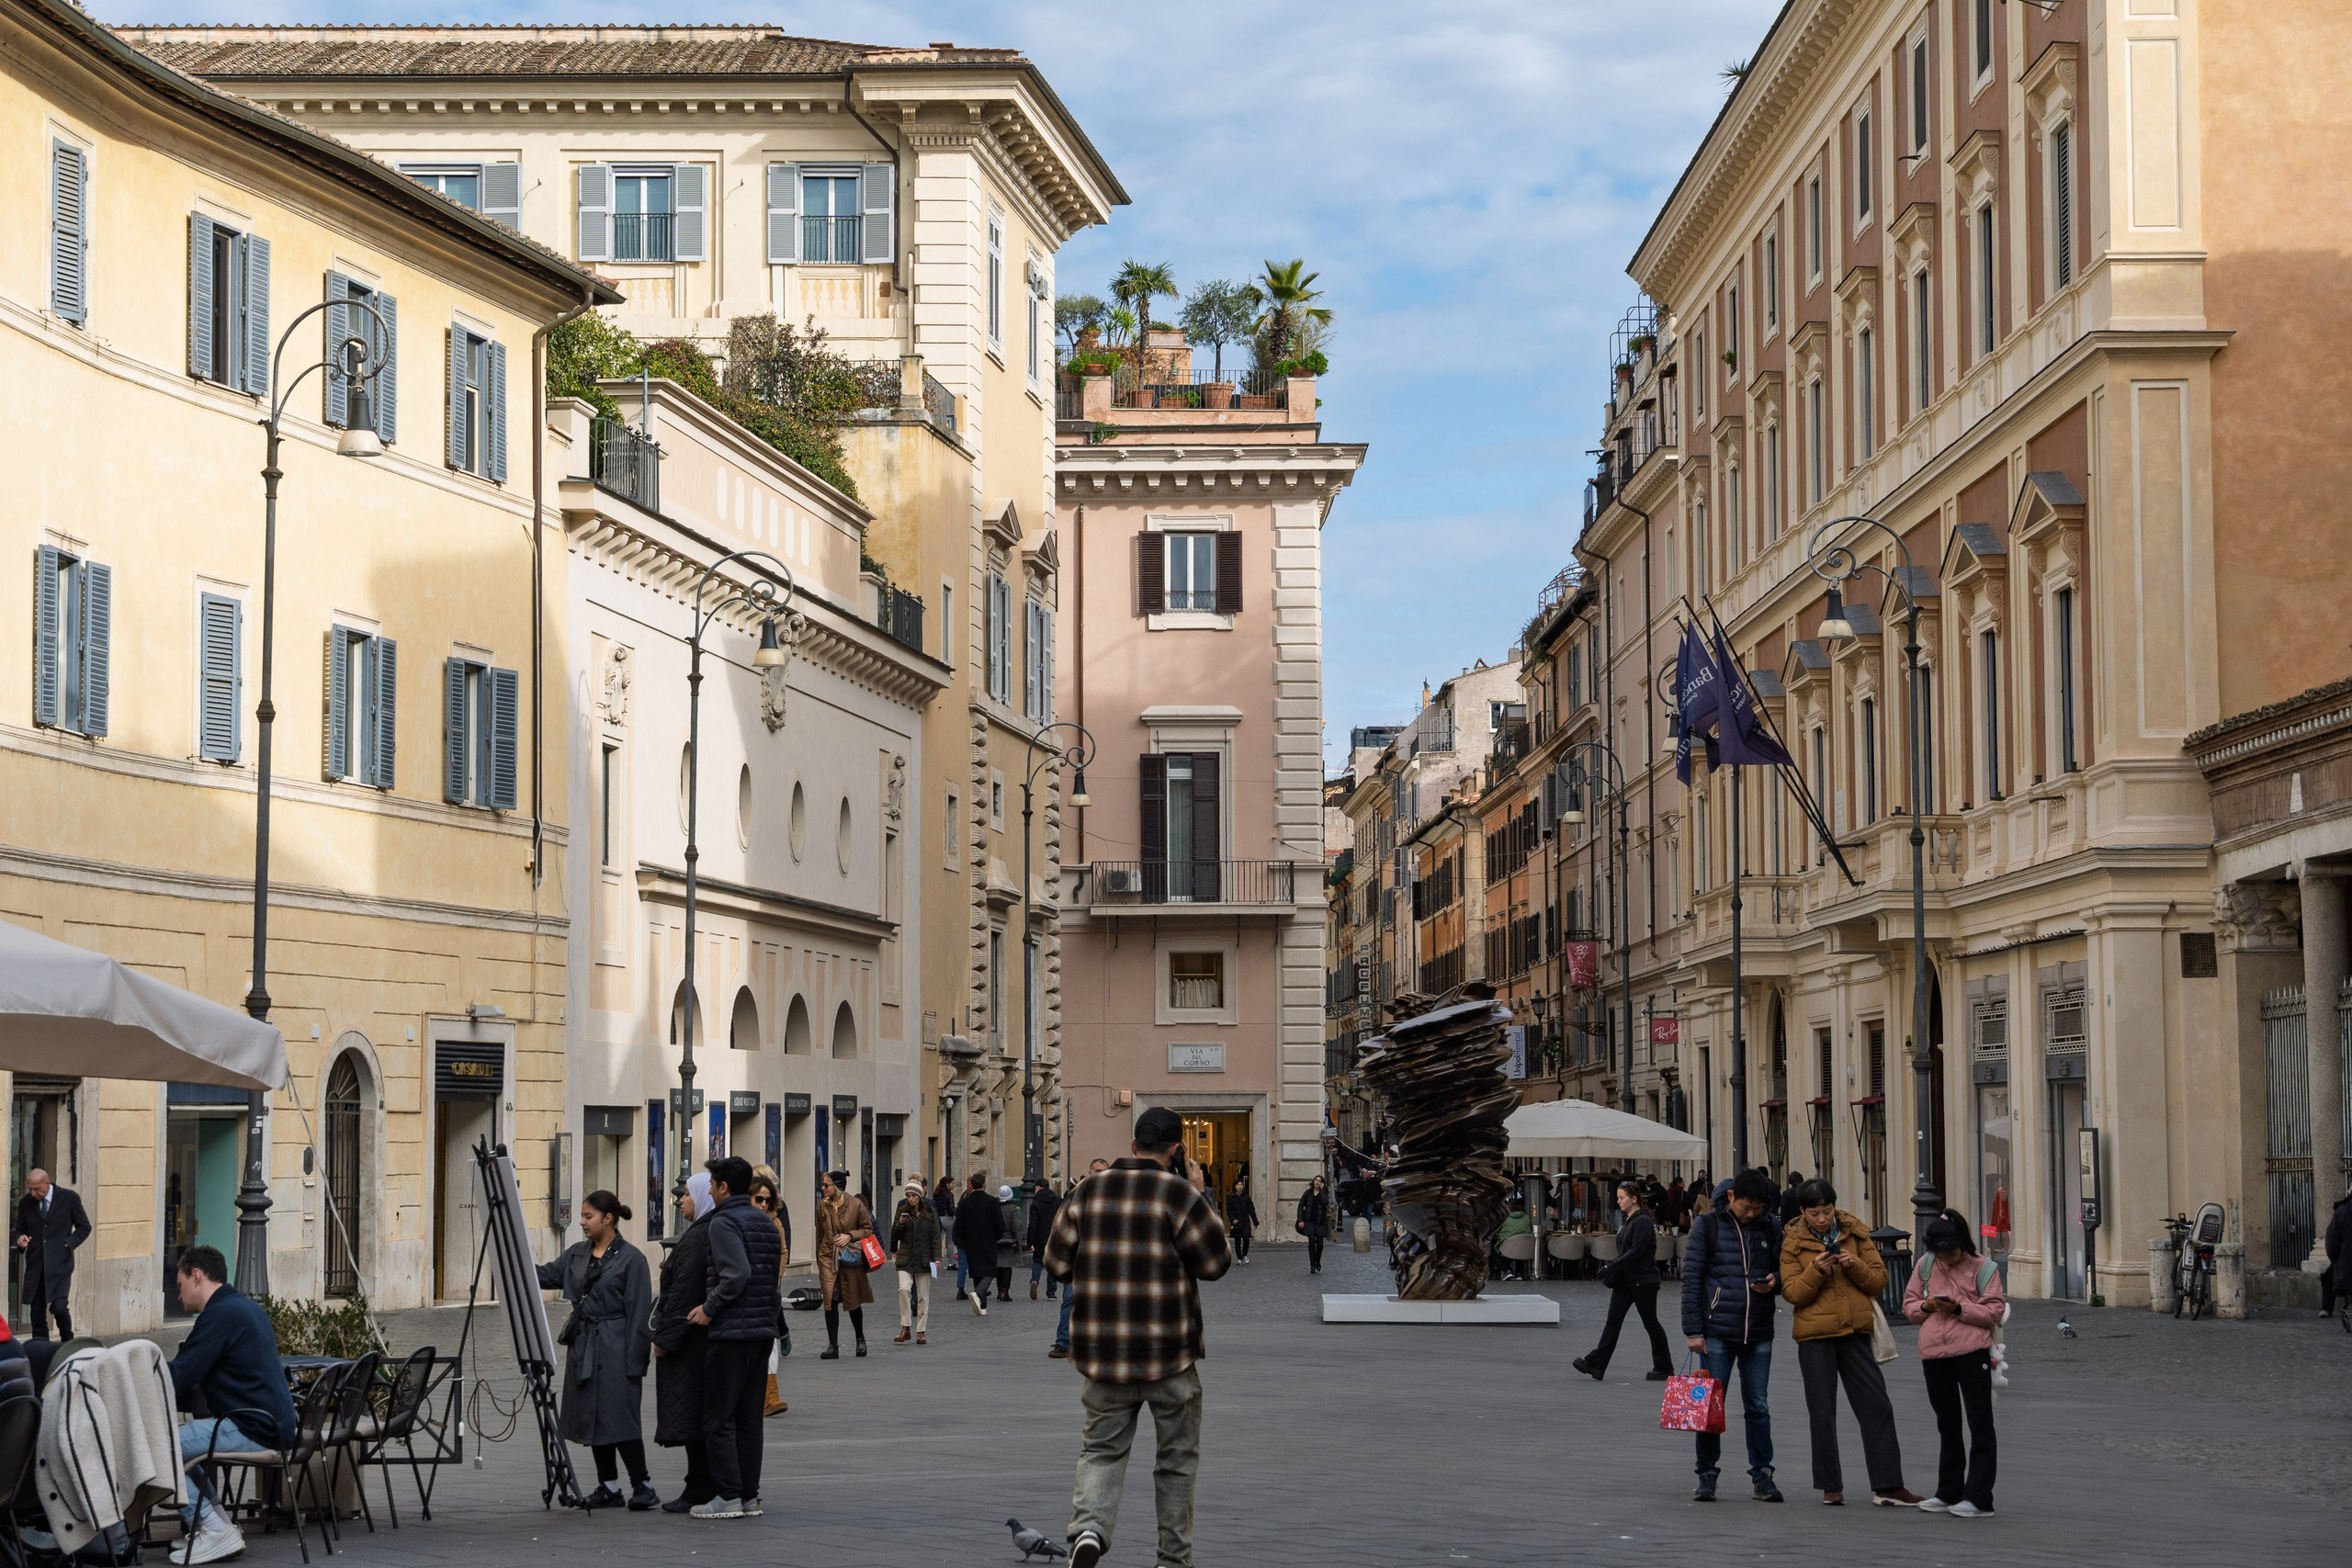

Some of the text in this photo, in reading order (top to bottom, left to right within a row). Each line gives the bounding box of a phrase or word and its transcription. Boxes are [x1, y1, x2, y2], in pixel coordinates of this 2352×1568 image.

[1655, 1022, 1678, 1040] Ray-Ba
[1513, 1032, 1523, 1077] UnipolRental
[452, 1062, 493, 1077] CASADEI
[733, 1097, 756, 1107] LOUIS VUITTON
[787, 1099, 808, 1108] LOUIS VUITTON
[843, 1100, 854, 1109] VUITTON
